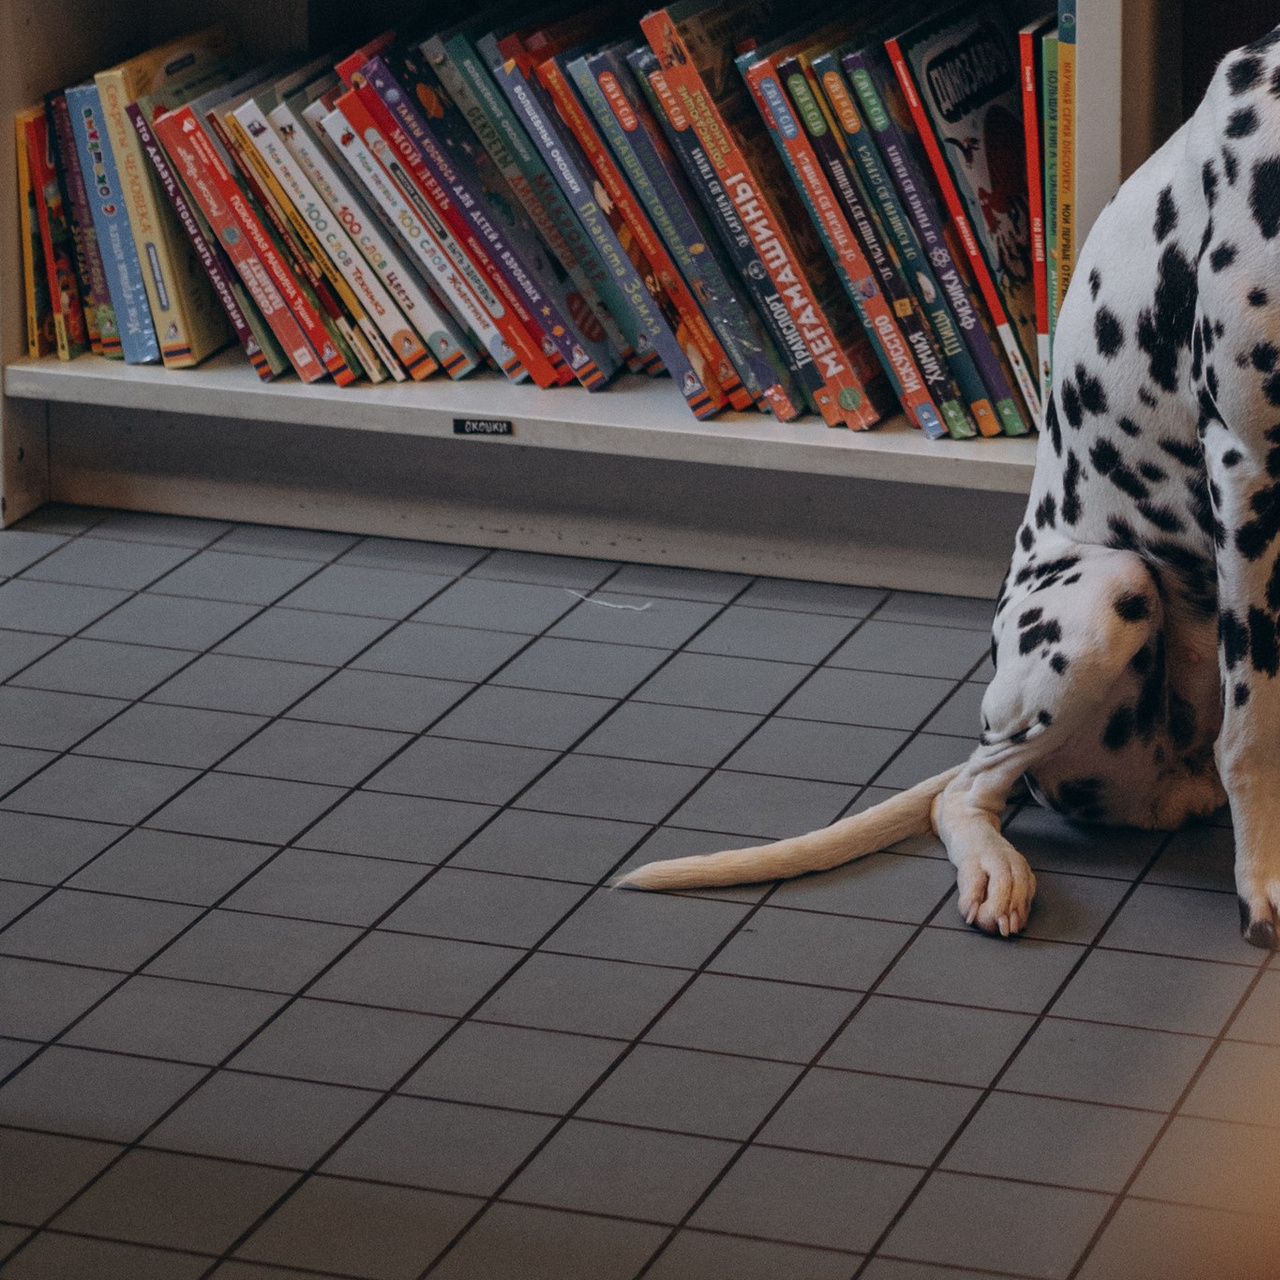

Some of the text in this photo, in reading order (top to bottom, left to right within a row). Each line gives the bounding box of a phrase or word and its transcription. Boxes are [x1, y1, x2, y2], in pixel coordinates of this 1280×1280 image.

[458, 57, 534, 163] ВОЛШЕБНЫЕ ОКОШКИ
[509, 83, 583, 195] ВОЛШЕБНЫЕ ОКОШКИ
[676, 82, 727, 170] ПОТРЯСАЮЩИЕ
[690, 86, 735, 156] ПАНОРАМЫ
[100, 82, 154, 234] Секреты ЧЕЛОВЕКА
[386, 123, 453, 214] МОЙ ДЕНЬ
[463, 102, 579, 274] СЕКРЕТЫ ДИНОЗАВРОВ
[575, 72, 695, 266] МОСТЫ БАШНИ ТОННЕЛИ
[227, 193, 317, 332] ПОЖАРНАЯ МАШИНА Тушик
[246, 252, 284, 313] ПЛАНЕТУ
[444, 240, 498, 310] БЫТЬ ЗДОРОВЫМ
[463, 234, 490, 266] КНИГА
[488, 269, 531, 324] ОКОШКАМИ
[573, 200, 664, 337] Планета Земля
[724, 173, 847, 380] МЕГАМАШИНЫ
[943, 272, 978, 334] ФИЗИКА
[762, 295, 814, 371] ТРАНСПОРТ
[873, 319, 918, 396] ИСКУССТВО
[910, 329, 946, 387] ХИМИЯ
[934, 312, 963, 359] ПТИЦЫ
[463, 419, 508, 434] ОКОШКИ
